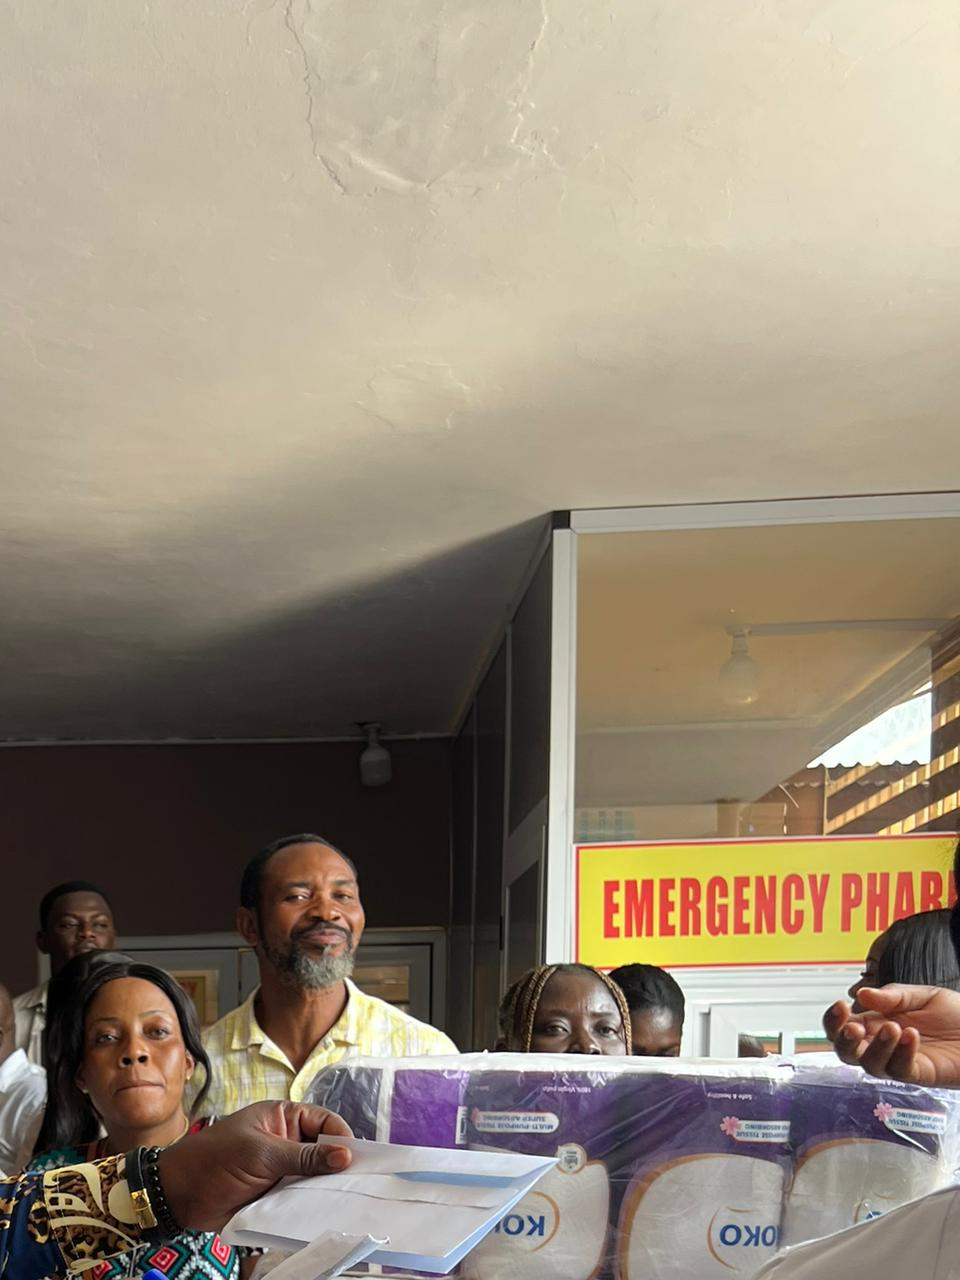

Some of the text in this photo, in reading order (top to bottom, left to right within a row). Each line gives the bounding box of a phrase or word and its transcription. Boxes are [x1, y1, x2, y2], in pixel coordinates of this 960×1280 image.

[603, 869, 959, 939] EMERGENCY PHAR
[491, 1214, 545, 1237] KO
[719, 1223, 779, 1247] OKO
